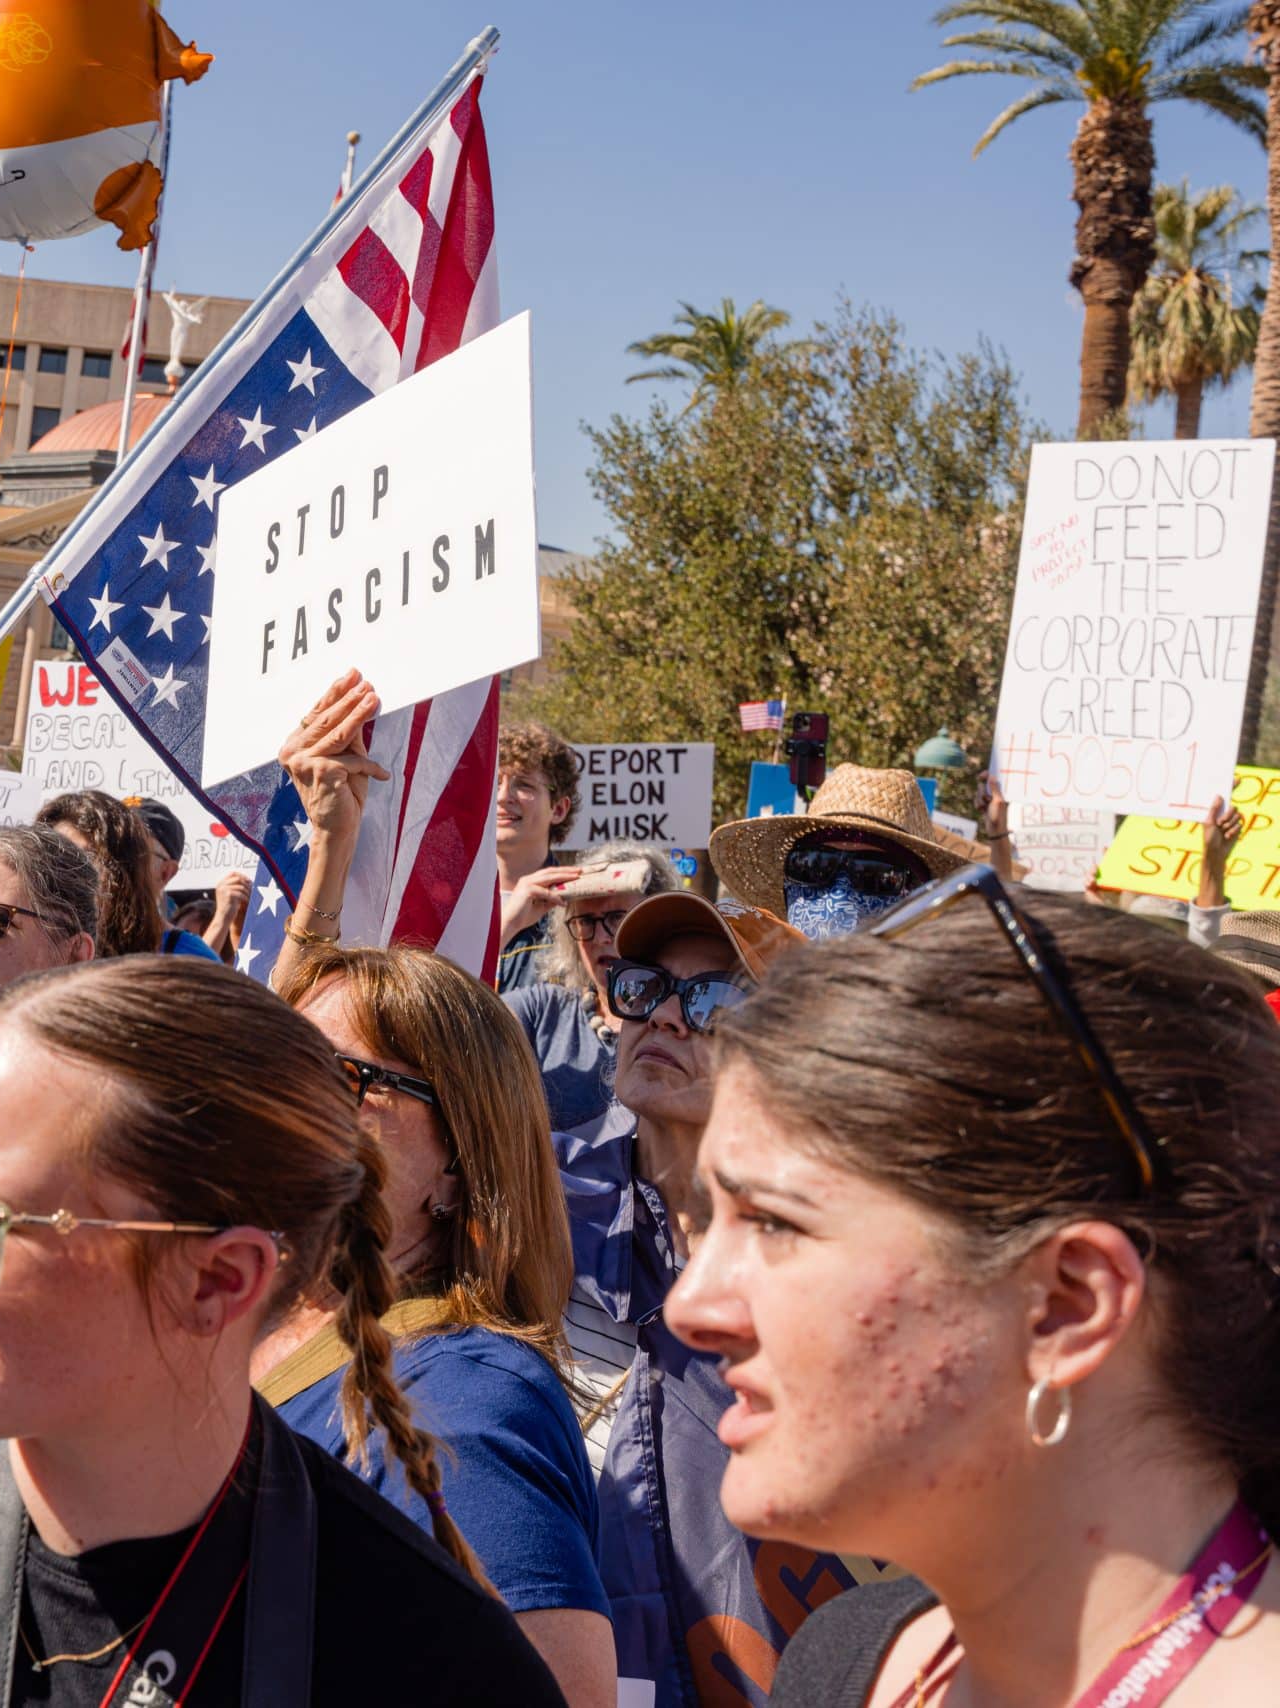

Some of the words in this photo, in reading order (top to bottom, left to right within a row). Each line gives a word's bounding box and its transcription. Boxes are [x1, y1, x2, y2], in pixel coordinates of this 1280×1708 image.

[1074, 454, 1142, 501] DO
[1151, 448, 1252, 500] NOT
[265, 464, 389, 574] STOP
[1093, 503, 1226, 560] FEED
[261, 518, 496, 675] FASCISM
[1091, 561, 1185, 616] THE
[1014, 614, 1256, 682] CORPORATE
[39, 666, 100, 708] WE
[1041, 676, 1194, 741] GREED
[28, 712, 128, 752] BECAU
[592, 781, 665, 806] ELON
[999, 731, 1209, 811] #50501
